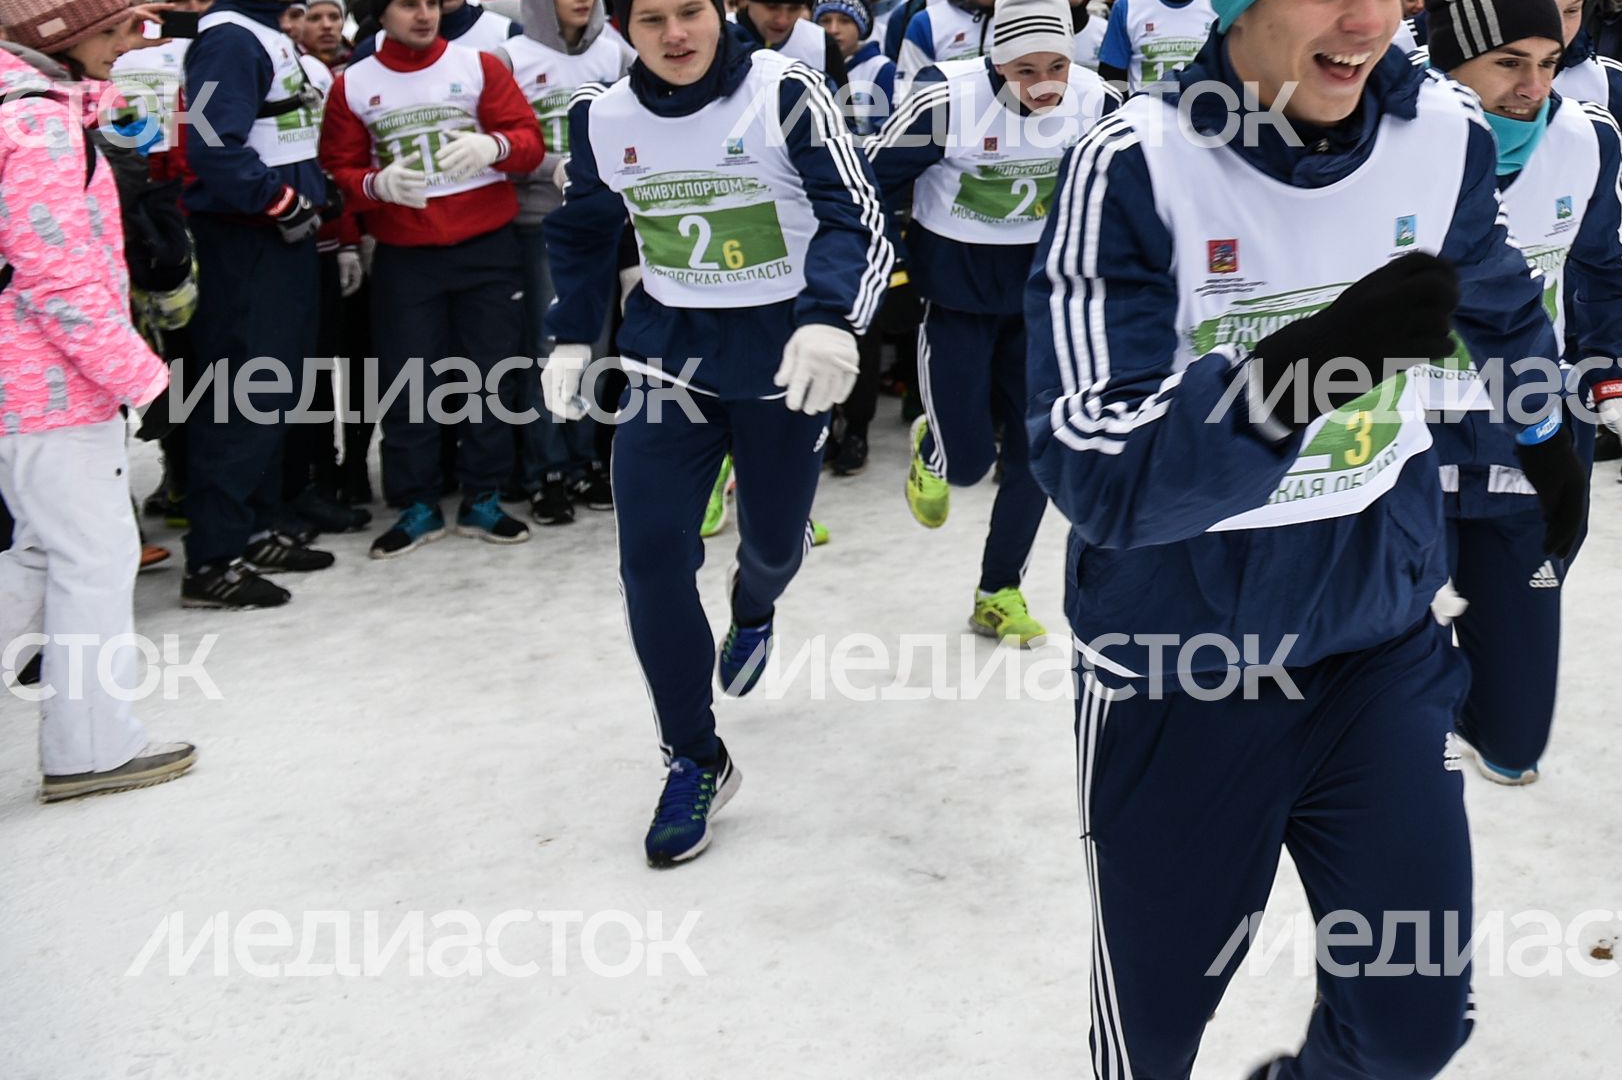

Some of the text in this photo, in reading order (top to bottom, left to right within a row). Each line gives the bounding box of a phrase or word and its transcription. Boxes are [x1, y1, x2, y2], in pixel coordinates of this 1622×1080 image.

[632, 178, 744, 202] #ЖИВУСПОРТОМ
[1005, 178, 1038, 220] 2
[678, 215, 745, 270] 2 6
[1344, 411, 1374, 466] 3
